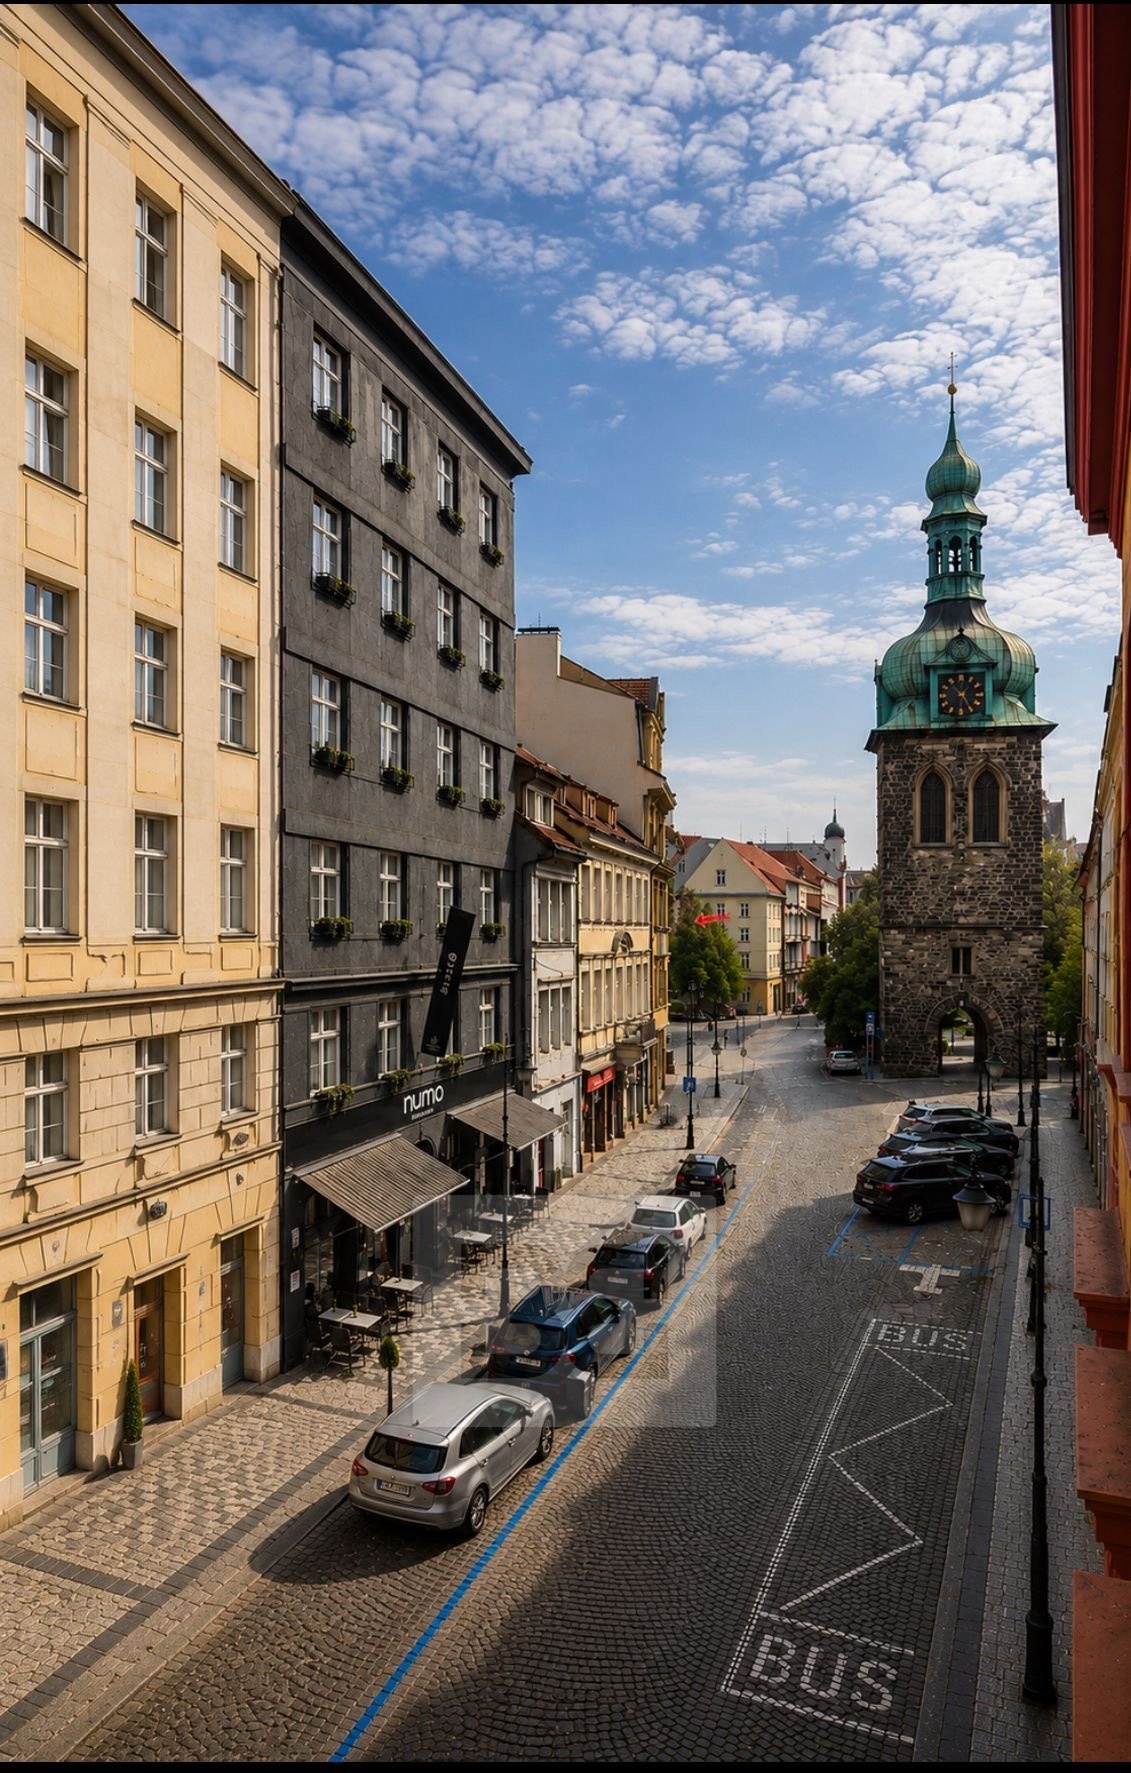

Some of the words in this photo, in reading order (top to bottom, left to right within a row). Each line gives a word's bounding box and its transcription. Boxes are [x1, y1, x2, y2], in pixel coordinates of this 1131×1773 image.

[404, 1085, 444, 1114] numo
[878, 1324, 967, 1351] BUS
[750, 1634, 898, 1711] BUS
